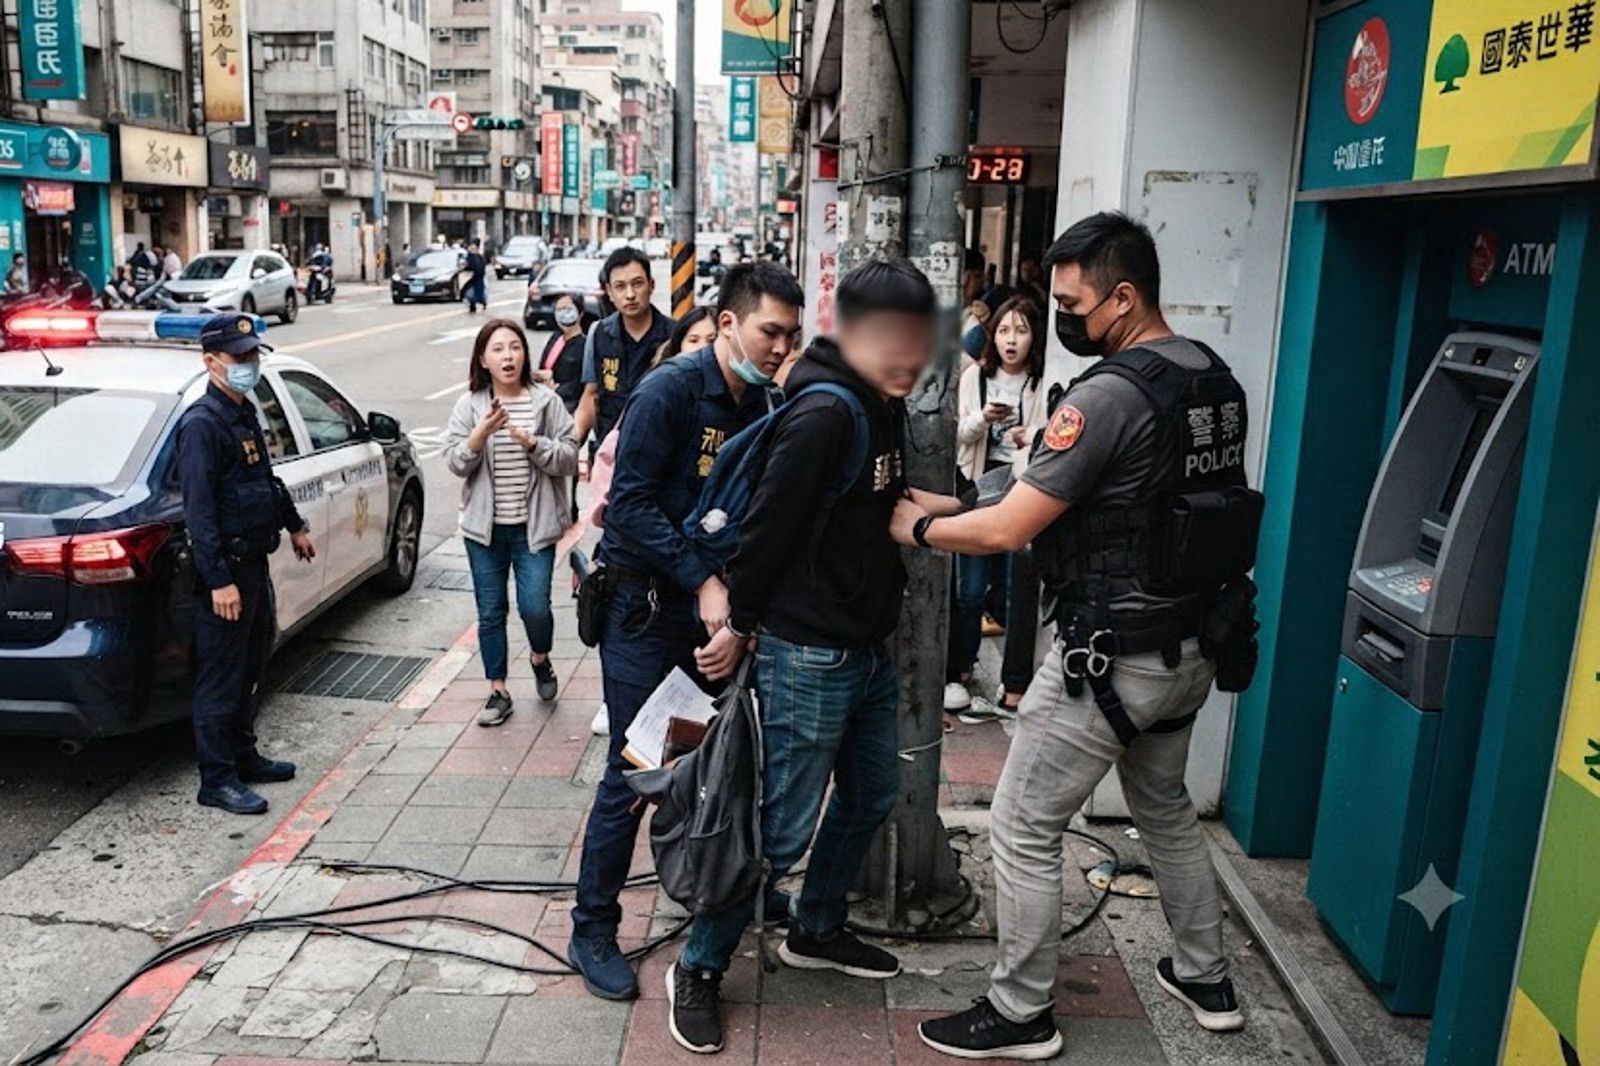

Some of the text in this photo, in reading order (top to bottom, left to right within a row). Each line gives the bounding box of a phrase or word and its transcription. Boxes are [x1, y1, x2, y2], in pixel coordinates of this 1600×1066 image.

[1480, 1, 1596, 76] 國泰世華
[1503, 243, 1557, 276] ATM
